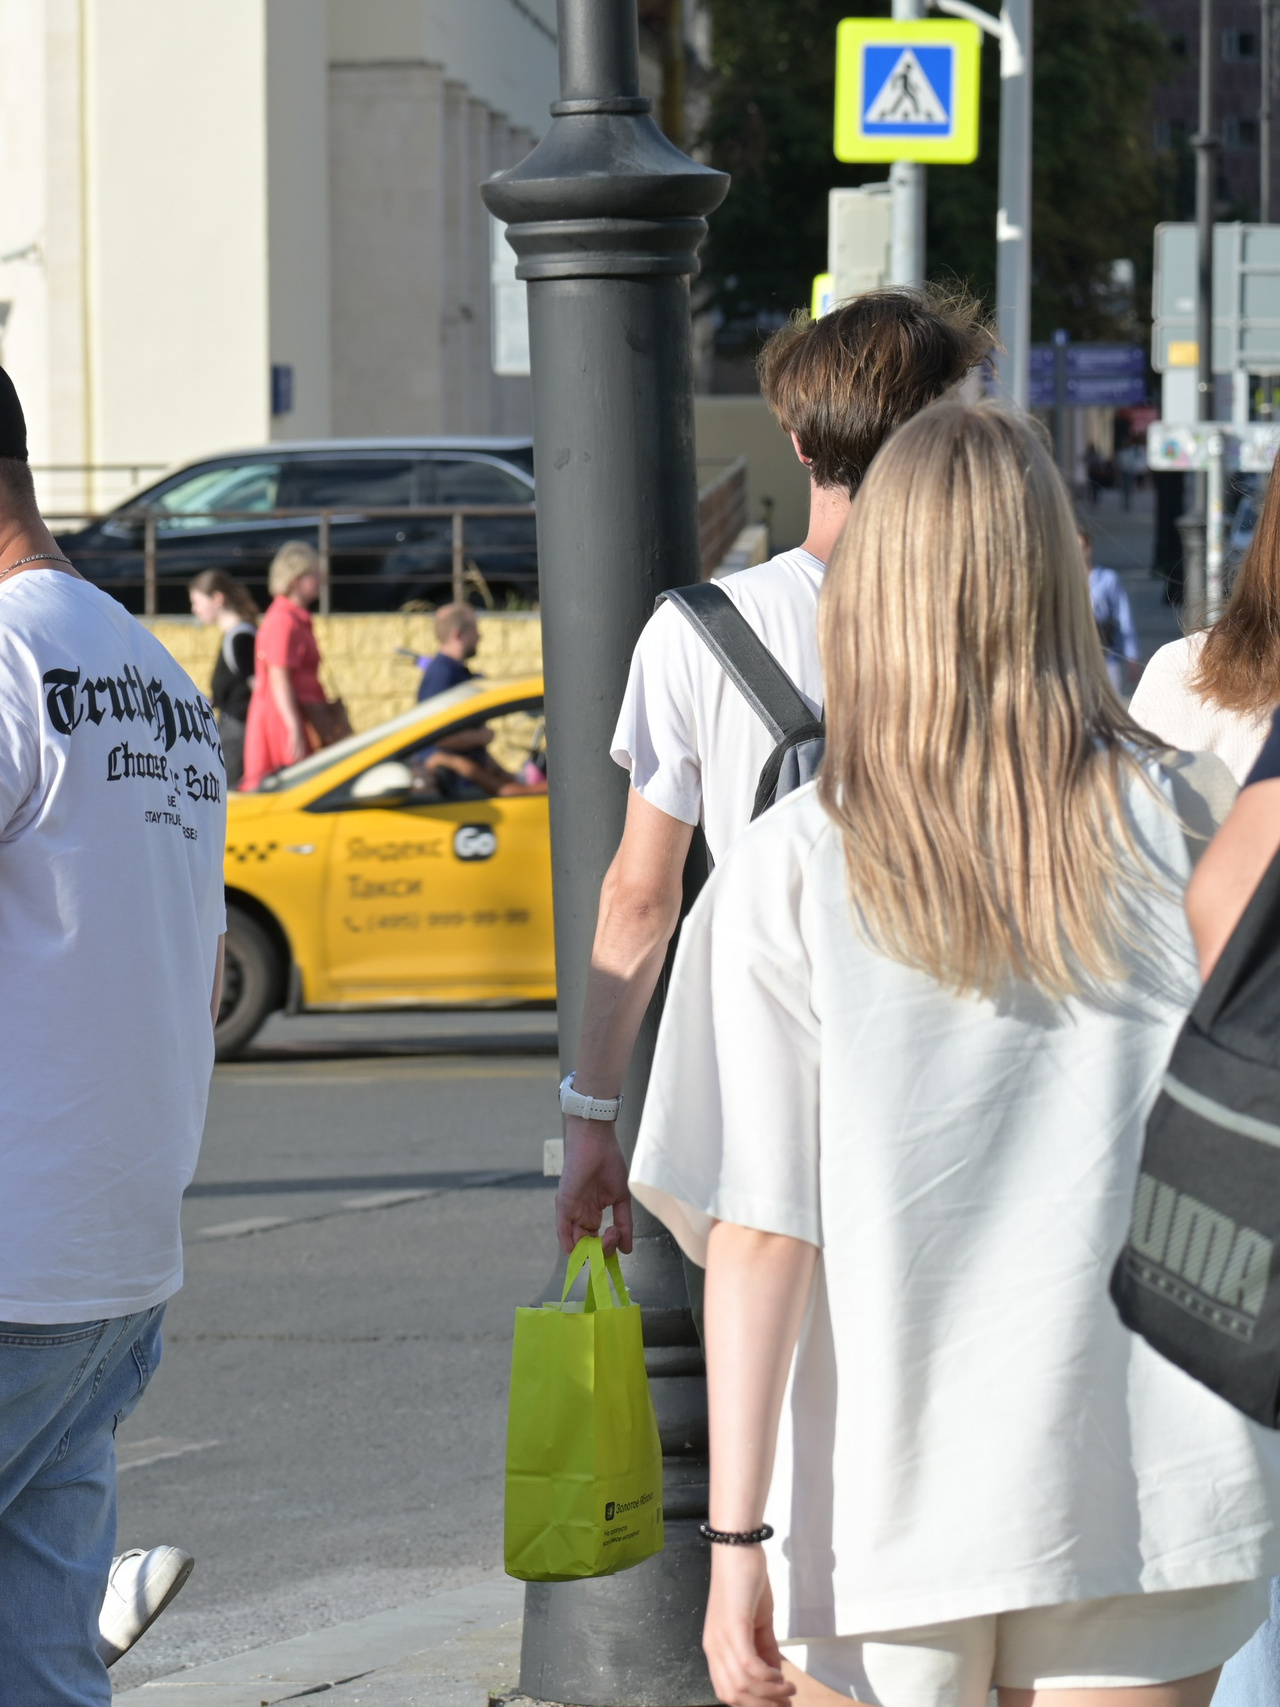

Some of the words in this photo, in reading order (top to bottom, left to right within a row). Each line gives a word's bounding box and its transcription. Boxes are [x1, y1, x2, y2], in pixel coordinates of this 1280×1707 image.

[145, 810, 162, 823] STAY
[163, 811, 182, 826] TRUE
[454, 826, 497, 858] Go
[347, 874, 423, 898] Такси
